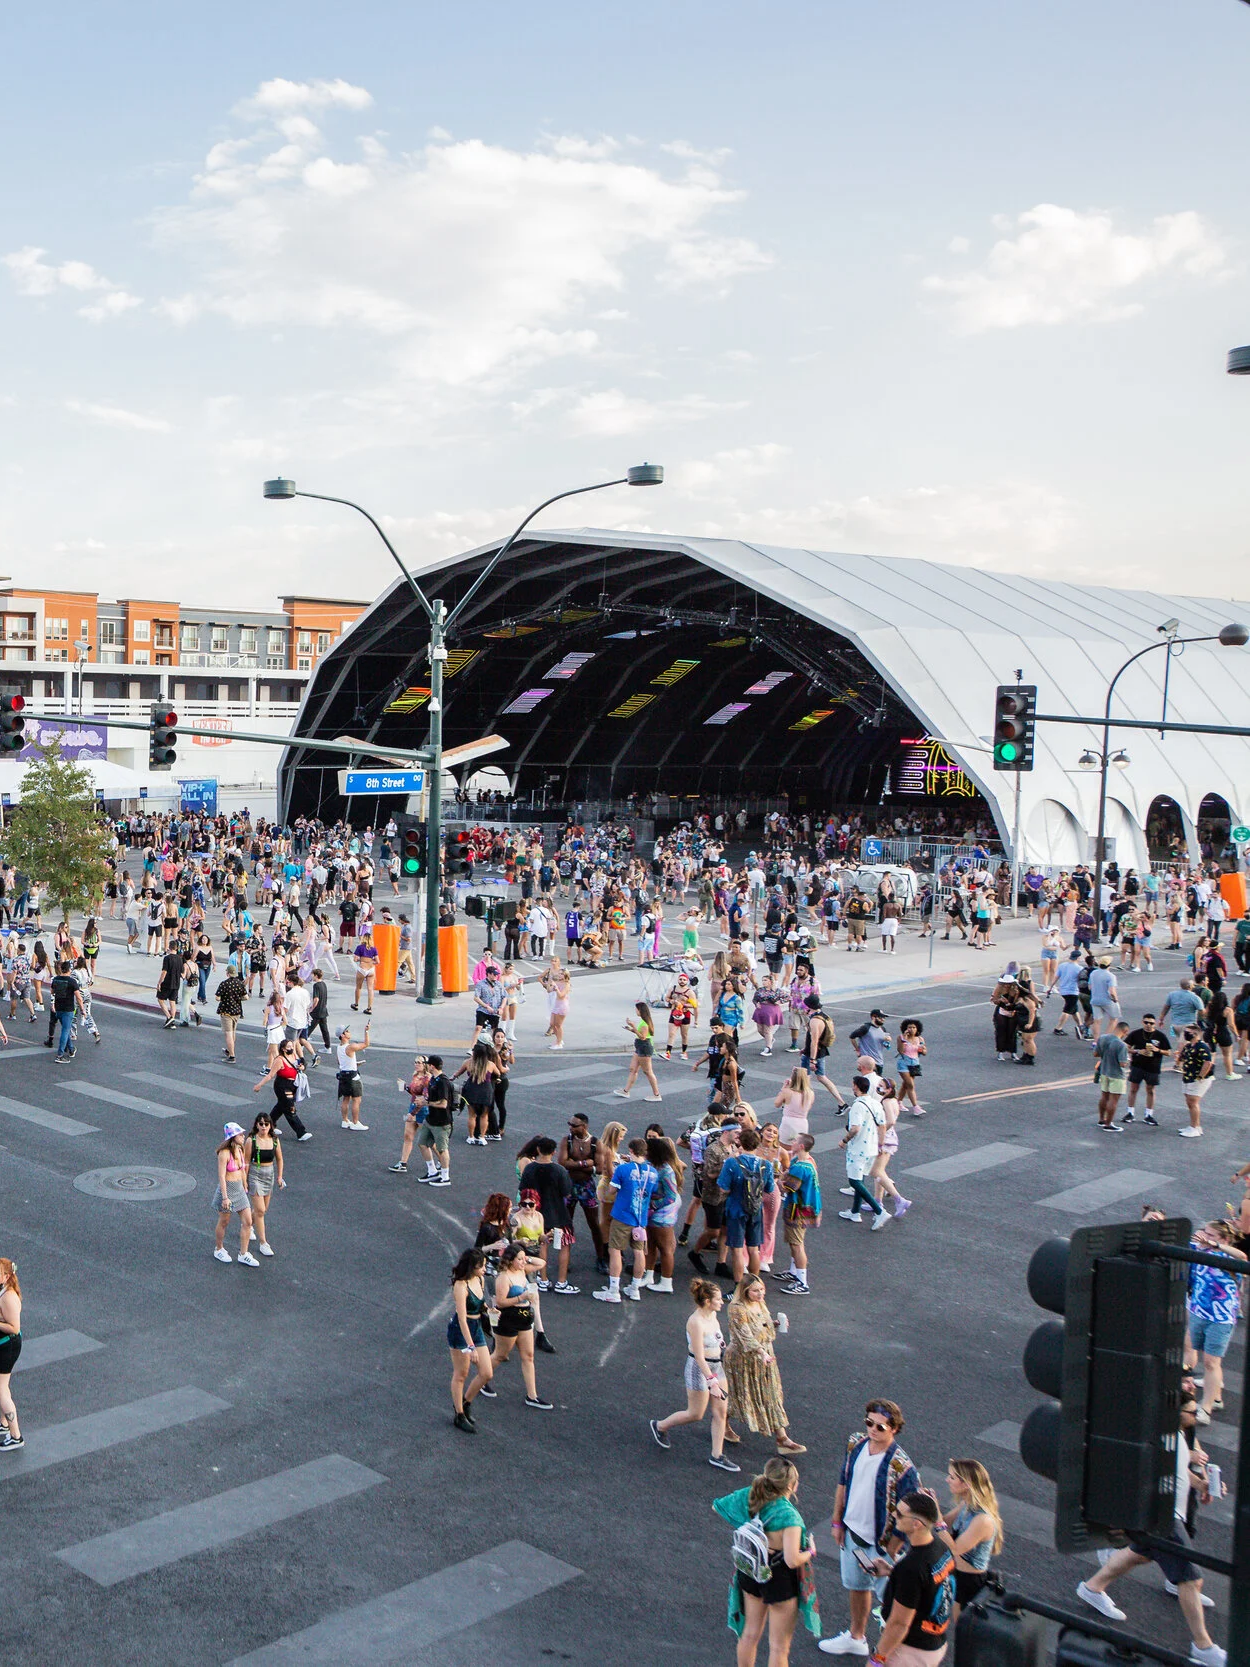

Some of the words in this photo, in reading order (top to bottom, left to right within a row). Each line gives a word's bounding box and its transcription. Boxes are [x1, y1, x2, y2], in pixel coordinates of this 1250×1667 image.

[365, 778, 380, 788] 8th
[382, 777, 405, 788] Street
[180, 783, 205, 793] VIP+
[181, 792, 200, 801] ALL
[202, 791, 214, 801] IN
